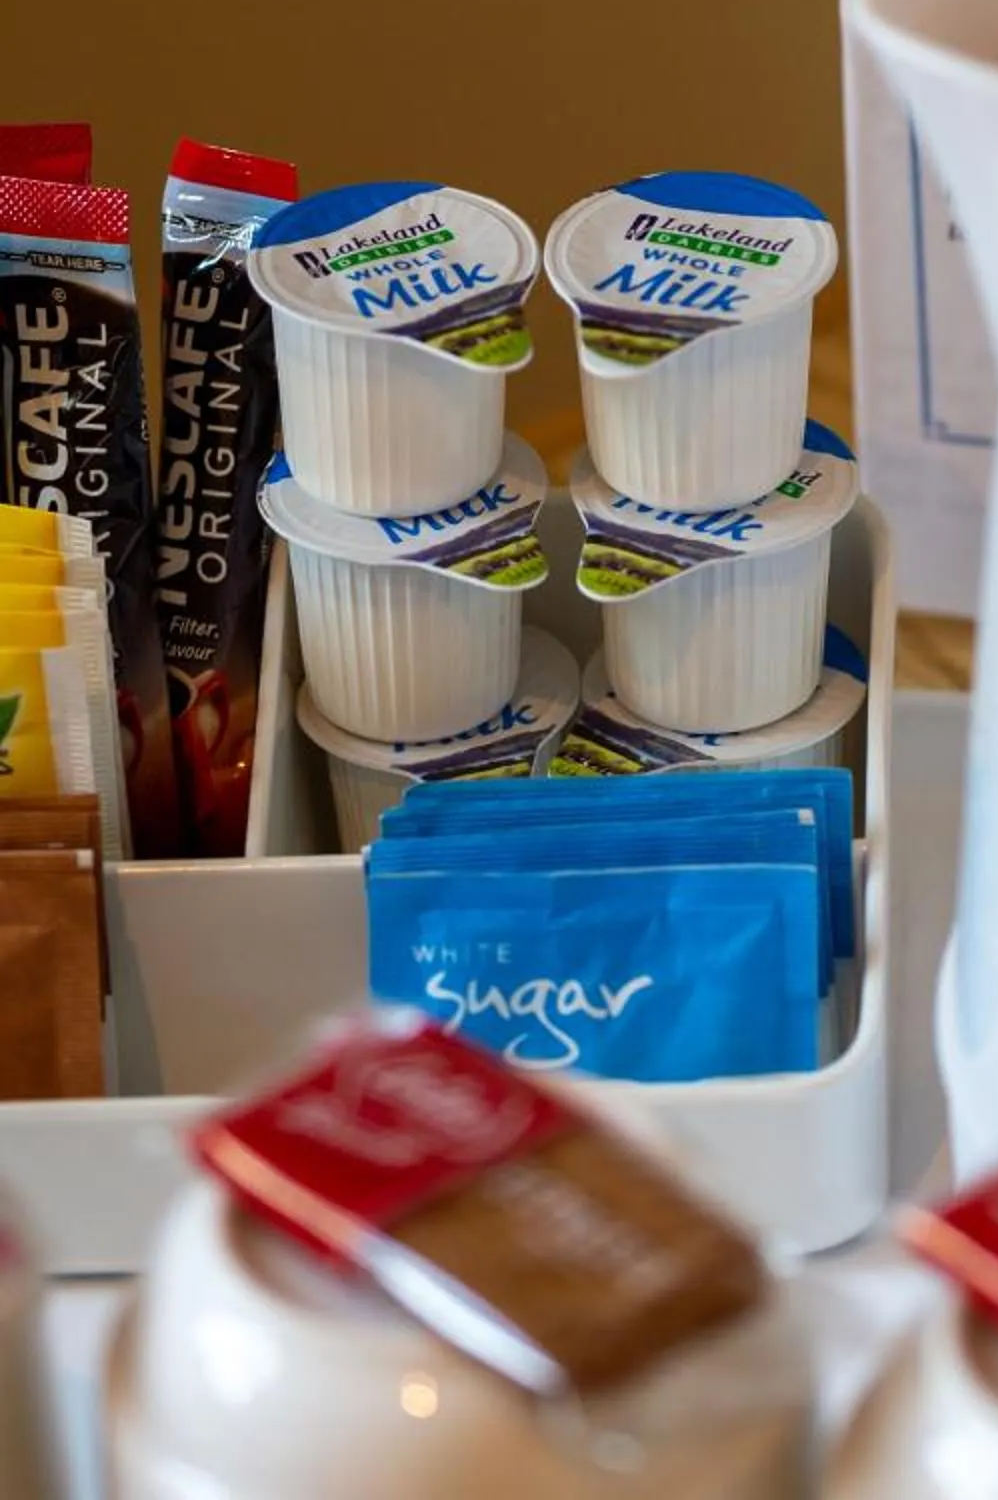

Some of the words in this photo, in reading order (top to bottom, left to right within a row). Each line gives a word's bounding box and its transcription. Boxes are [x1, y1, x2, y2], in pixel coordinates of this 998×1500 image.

[321, 213, 445, 261] Lakeland
[337, 232, 447, 267] DAIRIES
[656, 232, 771, 265] DAIRIES
[659, 217, 794, 252] Lakeland
[30, 252, 65, 269] TEAR
[66, 255, 104, 272] HERE
[345, 248, 448, 282] WHOLE
[642, 246, 748, 277] WHOLE
[352, 261, 498, 319] Milk
[593, 263, 751, 312] Milk
[196, 307, 248, 584] ORIGINAL
[411, 942, 513, 964] WHITE
